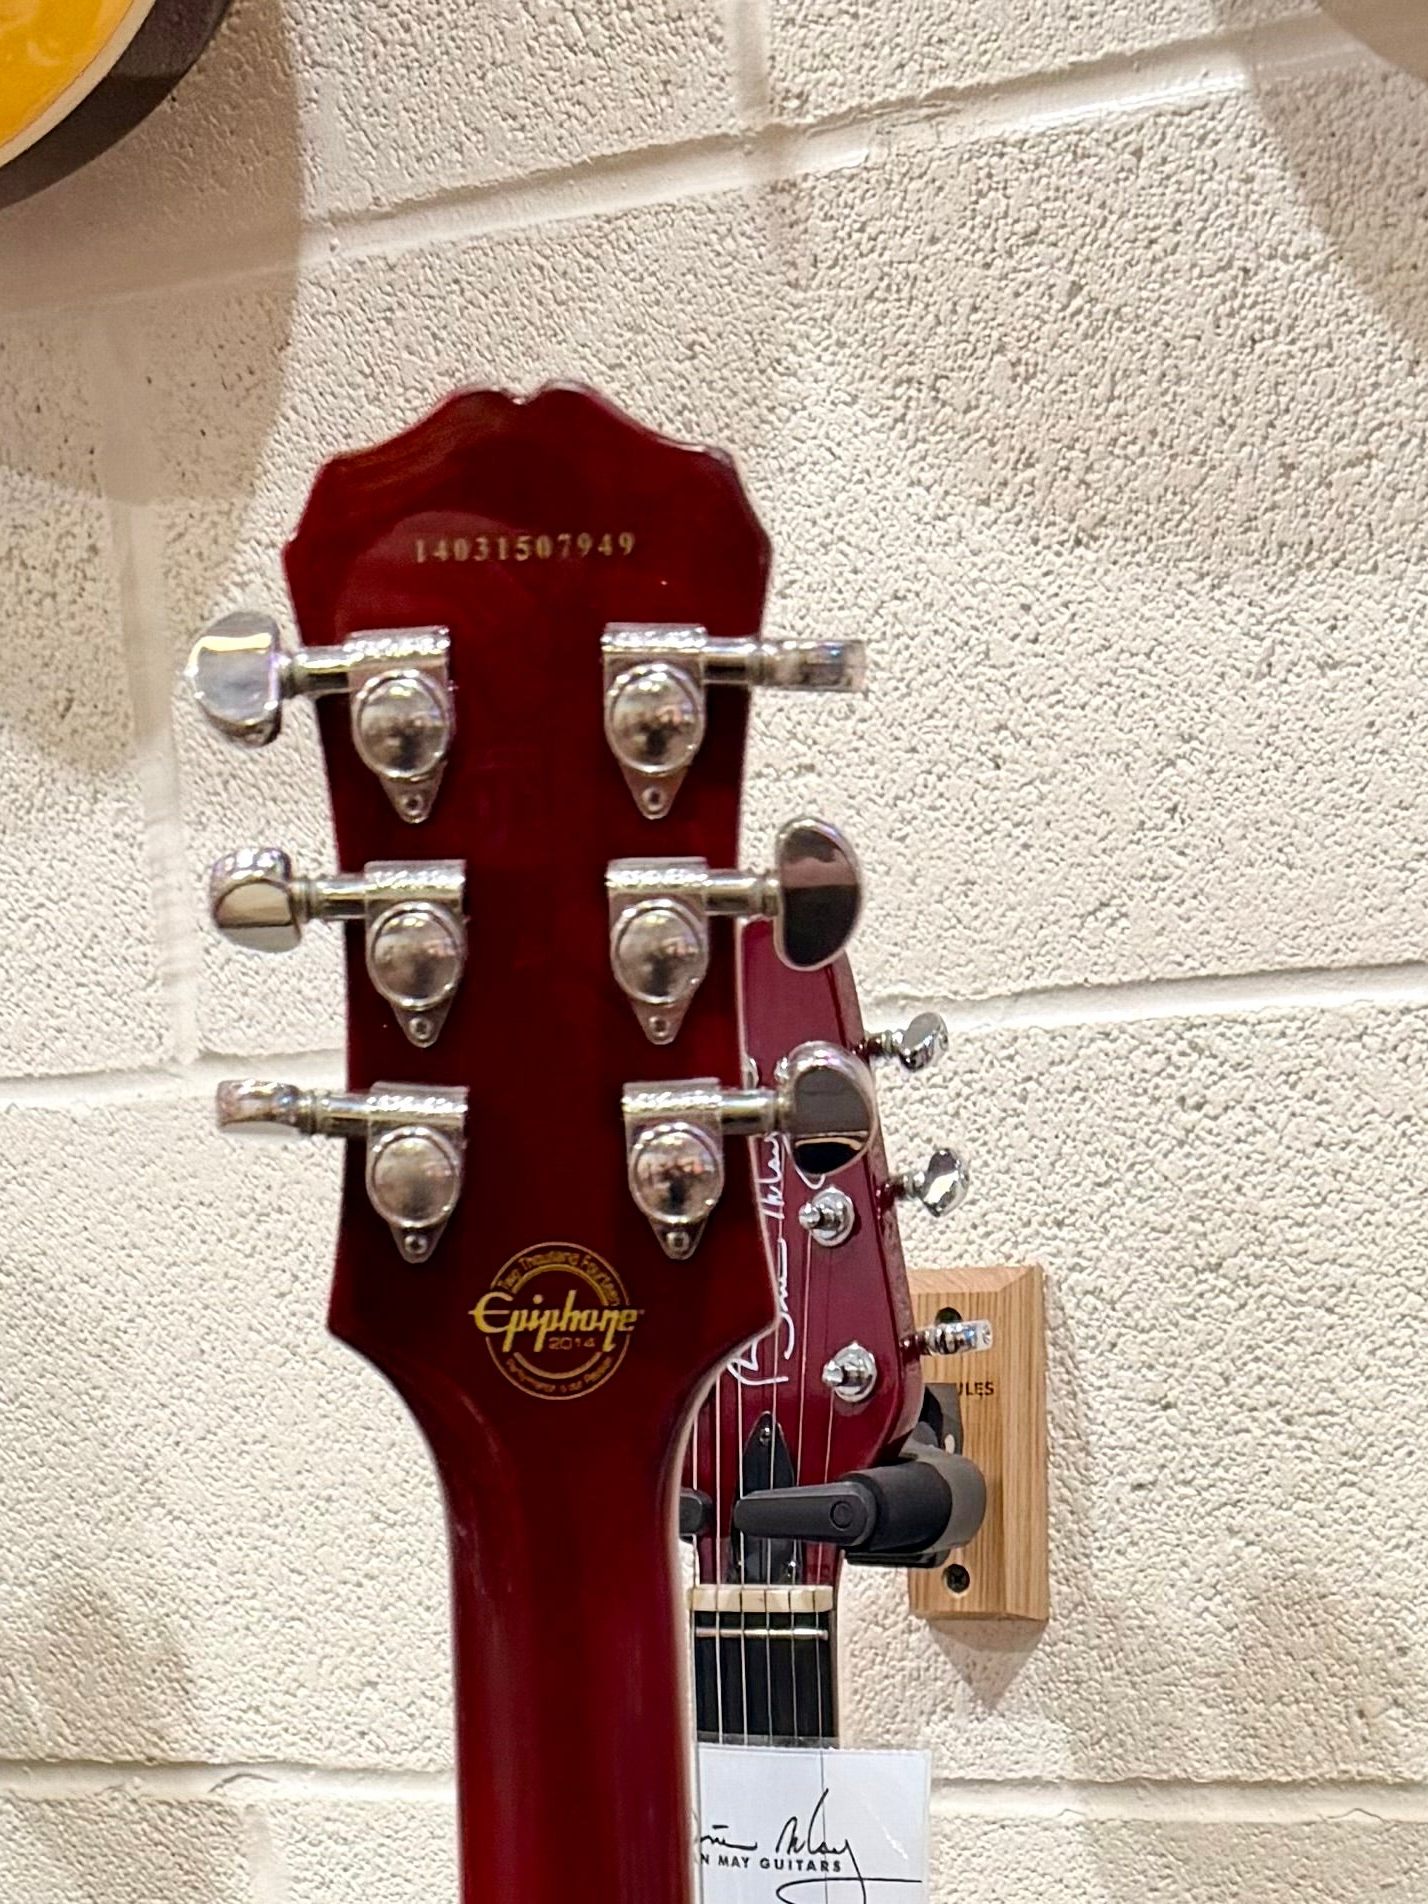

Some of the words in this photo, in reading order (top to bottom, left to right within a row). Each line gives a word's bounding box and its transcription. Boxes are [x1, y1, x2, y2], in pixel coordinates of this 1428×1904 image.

[415, 532, 635, 563] 14031507949
[468, 1289, 640, 1353] Epiphone
[548, 1336, 595, 1351] 2014
[717, 1854, 750, 1869] MAY
[759, 1857, 842, 1873] GUITARS
